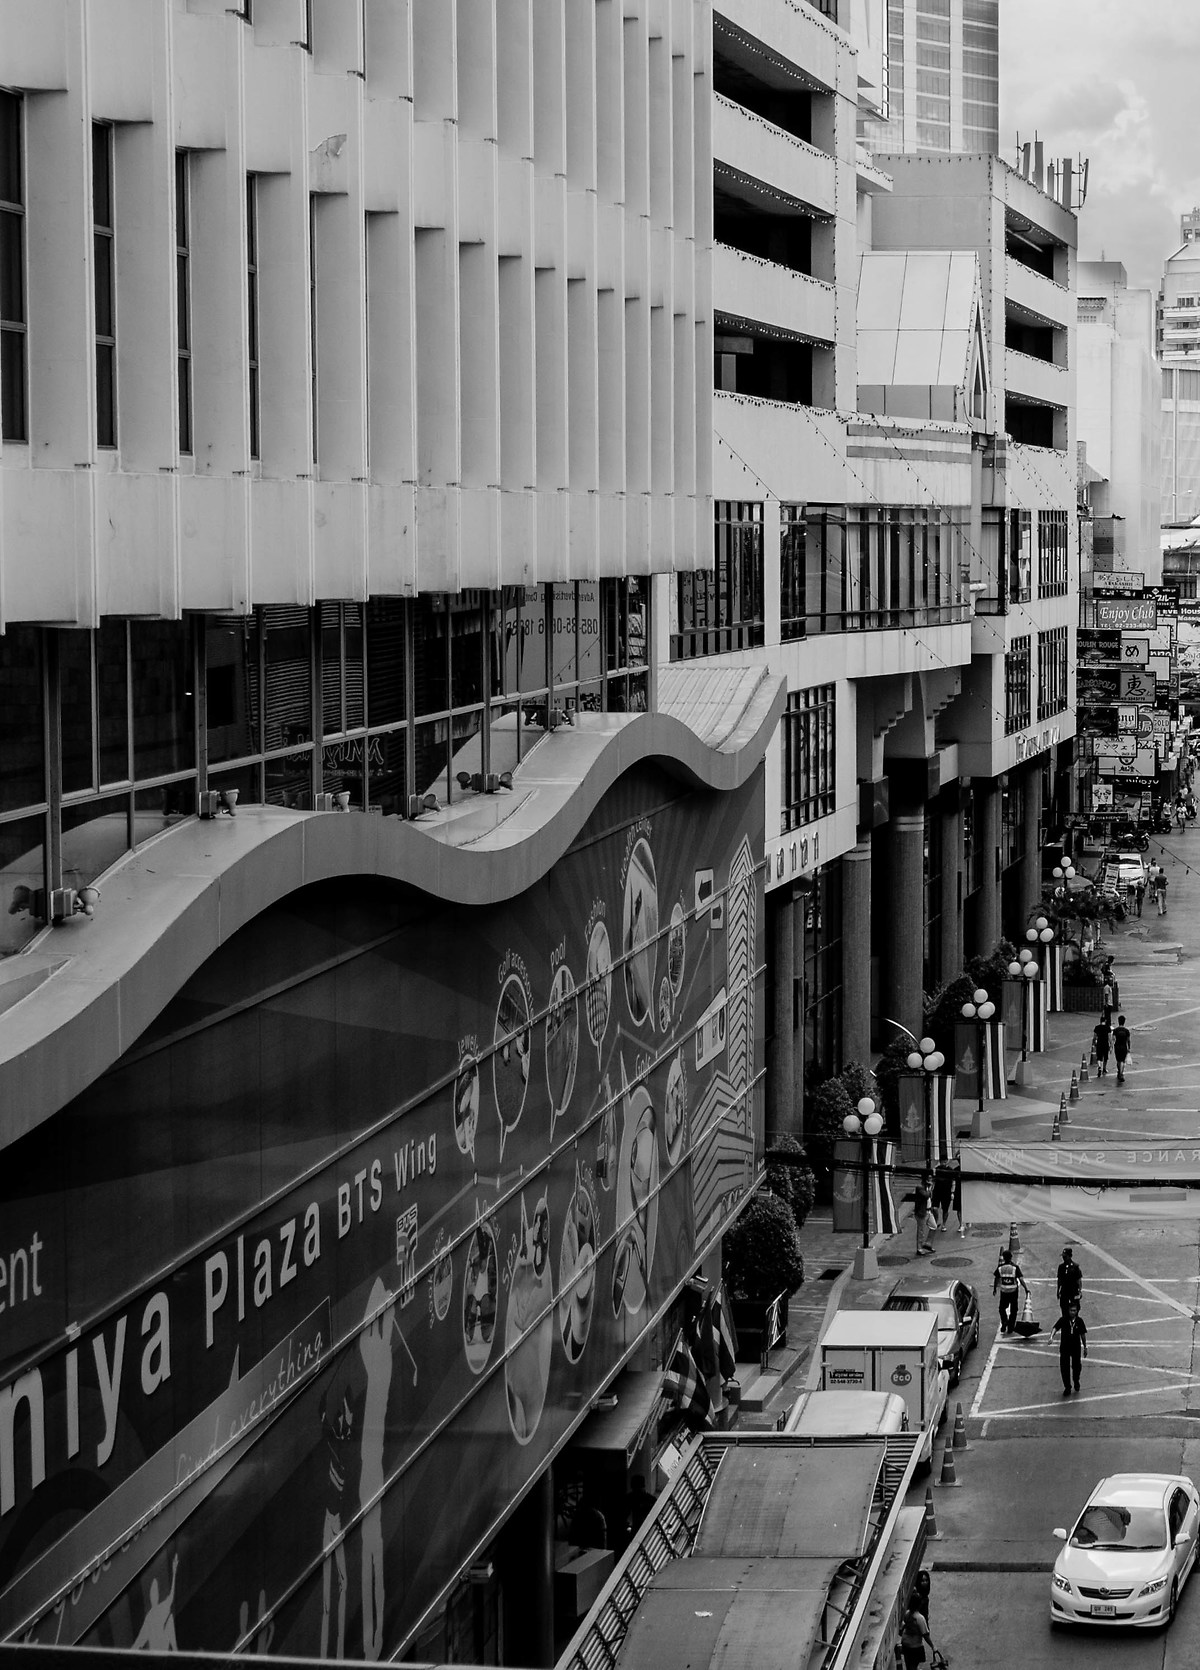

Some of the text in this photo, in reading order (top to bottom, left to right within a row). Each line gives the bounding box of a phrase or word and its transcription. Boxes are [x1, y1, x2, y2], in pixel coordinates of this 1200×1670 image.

[1100, 605, 1154, 623] Enjoy Club
[338, 1132, 439, 1240] BTS Wing
[204, 1201, 321, 1350] Plaza
[893, 1374, 911, 1382] eco
